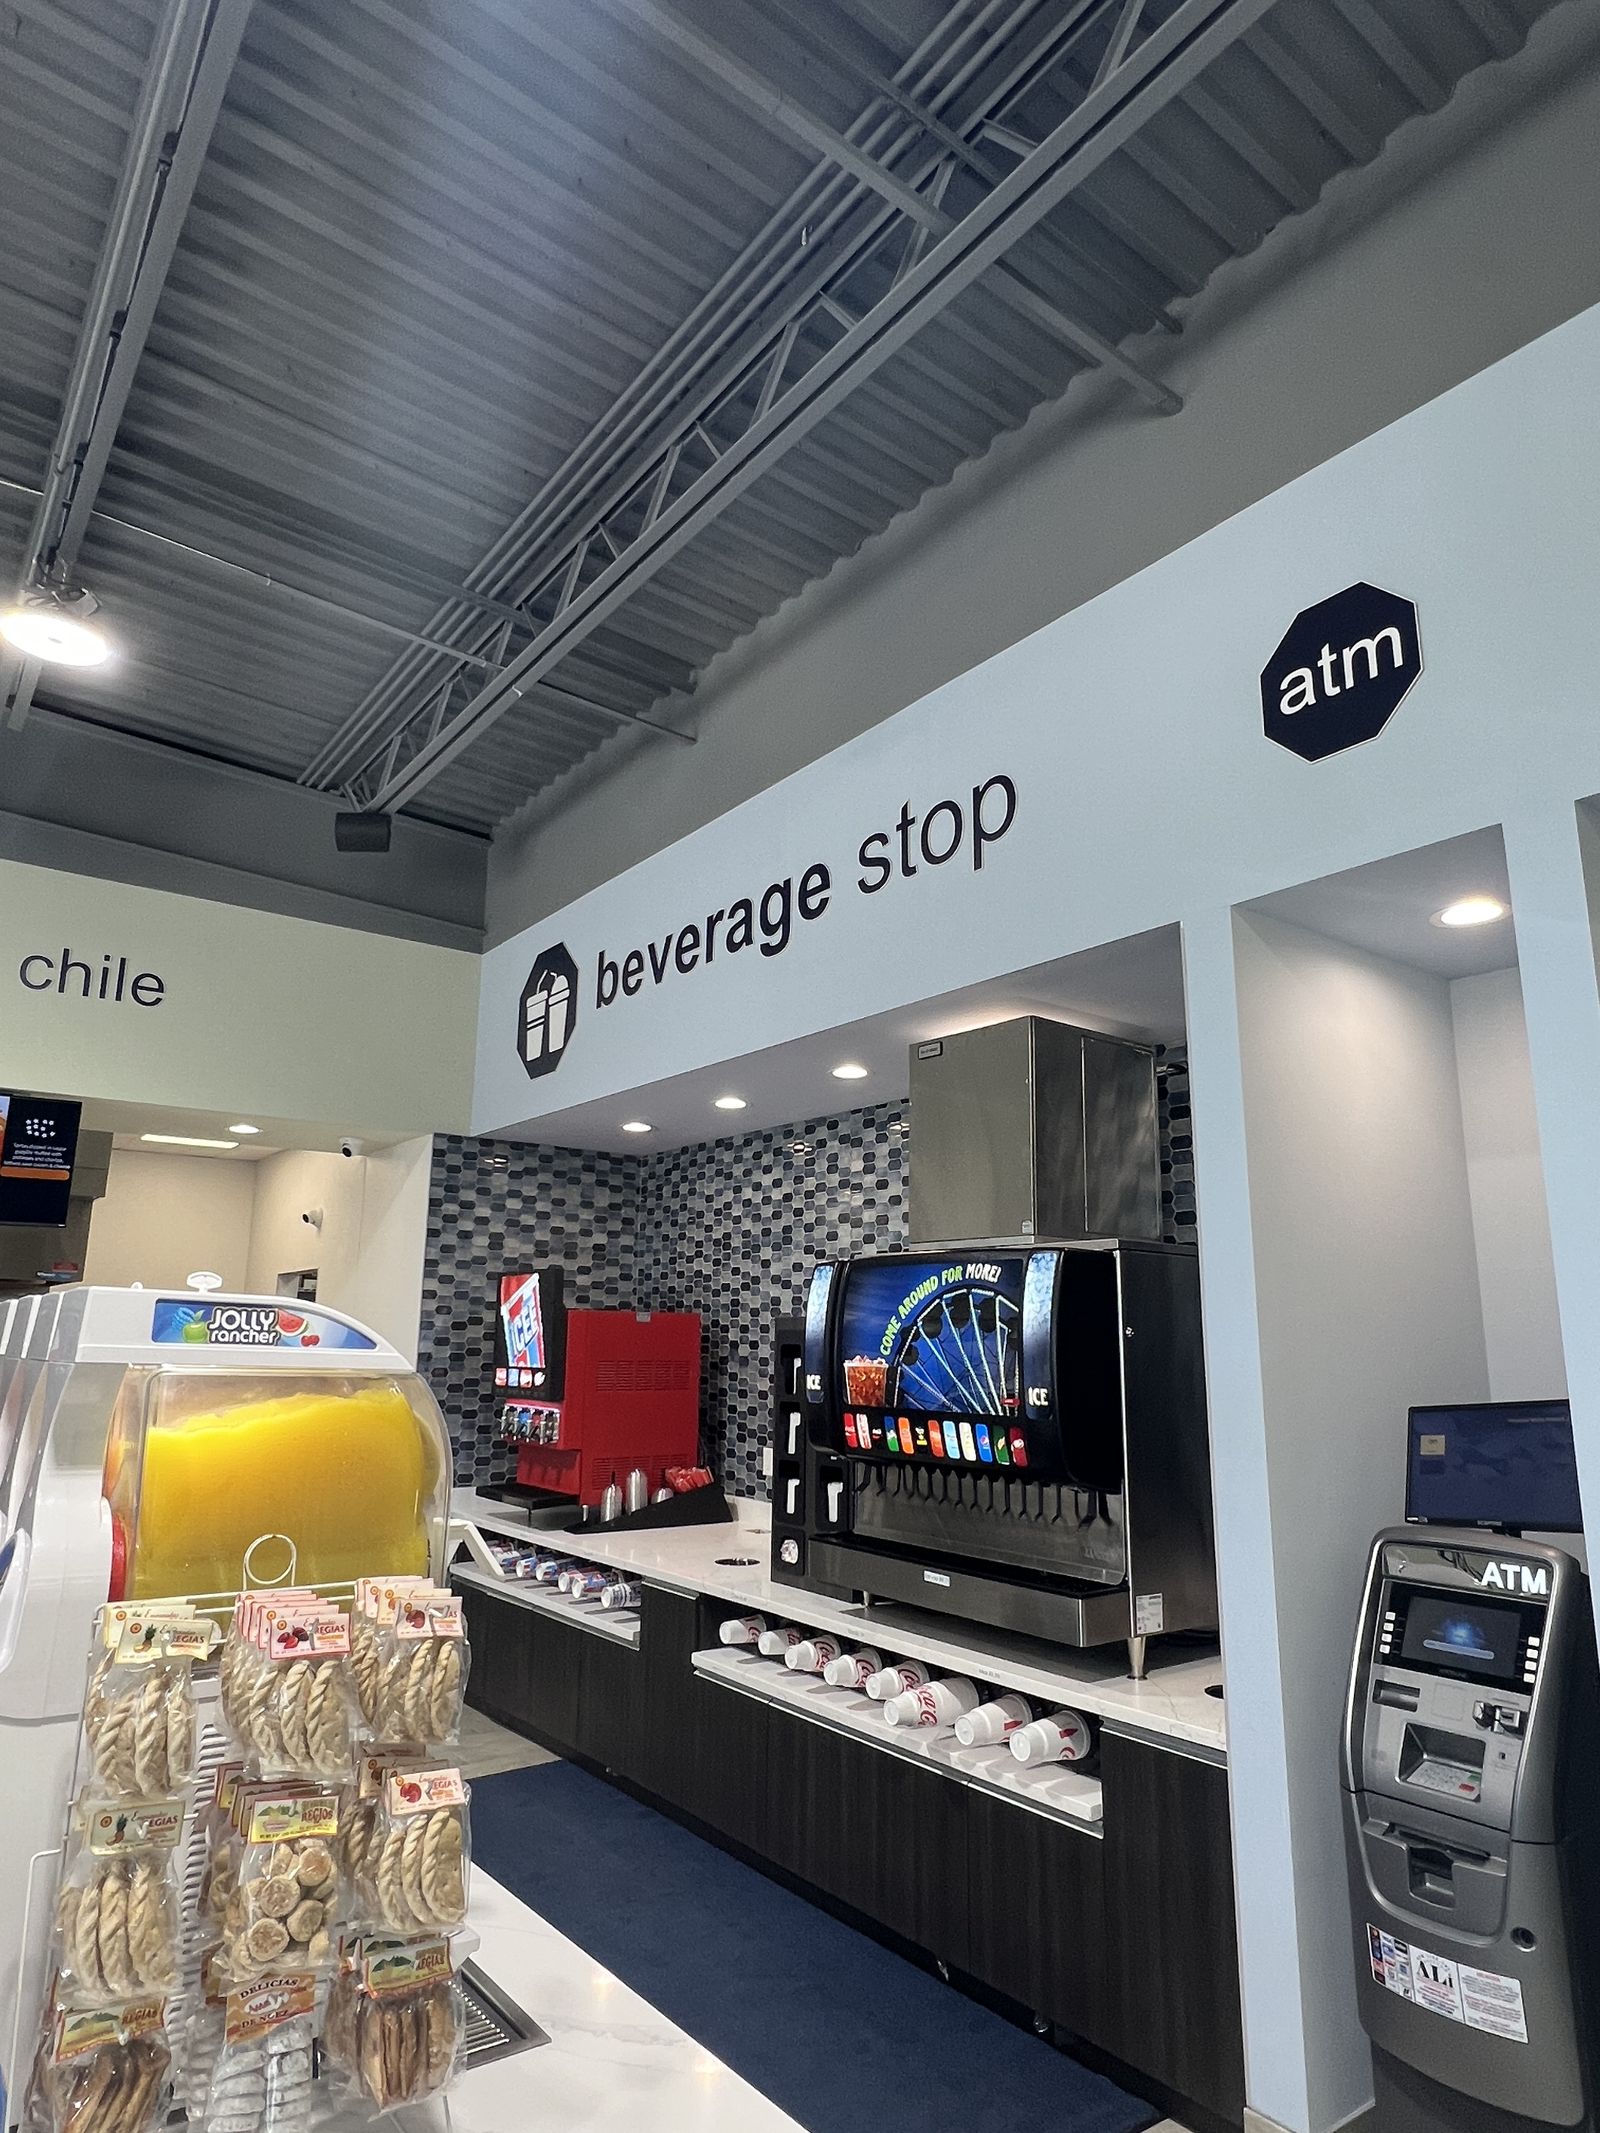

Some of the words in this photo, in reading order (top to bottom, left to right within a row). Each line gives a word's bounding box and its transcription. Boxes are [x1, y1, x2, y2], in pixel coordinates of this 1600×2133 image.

[1279, 626, 1404, 716] atm
[596, 862, 831, 1010] beverage
[857, 774, 1016, 895] stop
[19, 948, 166, 1007] chile
[209, 1309, 275, 1331] JOLLY
[880, 1315, 901, 1355] COME
[898, 1276, 939, 1319] AROUND
[941, 1265, 963, 1286] FOR
[966, 1263, 1001, 1283] MORE!
[211, 1329, 277, 1344] rancher
[806, 1374, 821, 1390] ICE
[1028, 1386, 1049, 1406] ICE
[1481, 1561, 1547, 1595] ATM
[240, 1979, 299, 1999] DELICIAS
